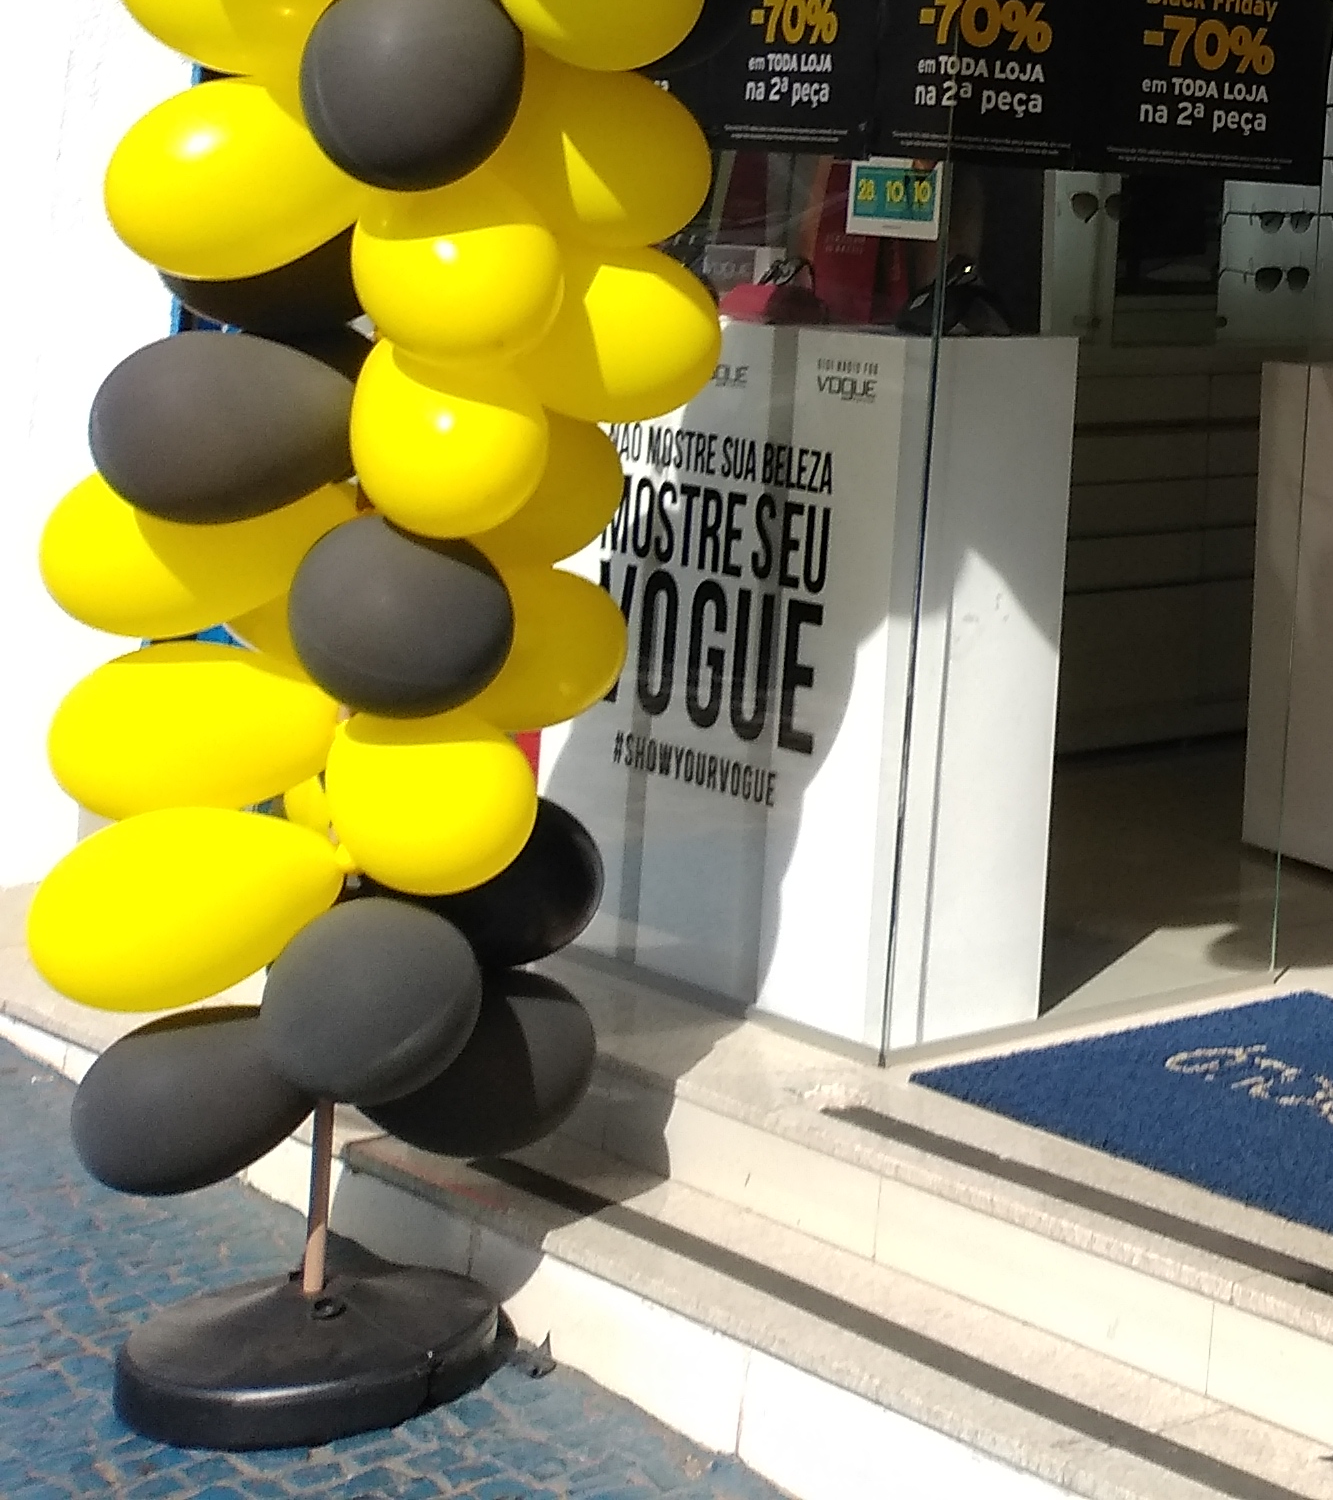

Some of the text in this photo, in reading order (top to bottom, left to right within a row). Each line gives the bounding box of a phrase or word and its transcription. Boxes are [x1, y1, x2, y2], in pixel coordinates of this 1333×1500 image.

[748, 53, 833, 73] em TODA LOJA
[1143, 14, 1275, 75] -70%
[745, 80, 766, 100] na
[791, 81, 830, 109] peça
[1139, 103, 1168, 124] na
[1212, 109, 1267, 136] peça
[1141, 77, 1269, 103] em TODA LOJA
[646, 425, 718, 476] MOSTRE
[721, 435, 756, 483] SUA
[761, 441, 833, 495] BELEZA
[601, 474, 832, 594] MOSTRE SEU
[600, 560, 824, 755] VOGUE
[612, 729, 777, 807] #SHOWYOURVOGUE
